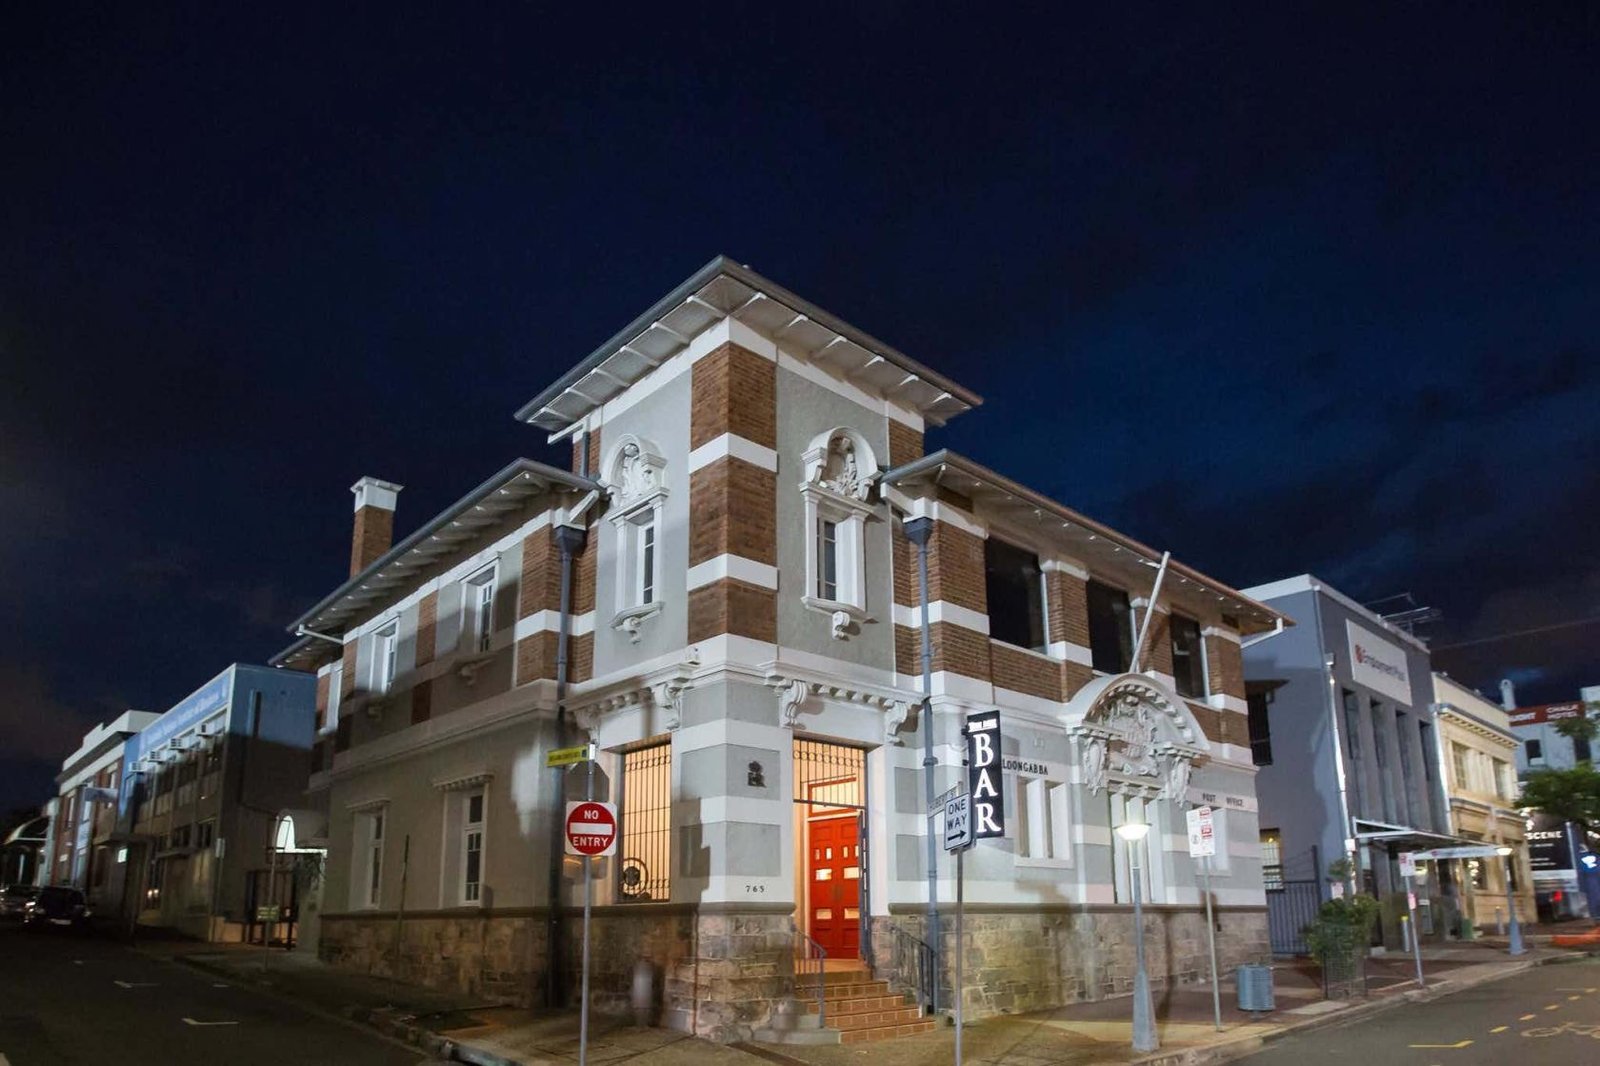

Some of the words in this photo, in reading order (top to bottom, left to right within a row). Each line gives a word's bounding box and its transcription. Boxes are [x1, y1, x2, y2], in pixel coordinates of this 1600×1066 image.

[1002, 759, 1048, 775] LOONGABBA
[973, 733, 1001, 833] BAR
[584, 810, 599, 819] NO
[948, 799, 966, 815] ONE
[947, 814, 967, 830] WAY
[573, 836, 609, 847] ENTRY
[745, 885, 764, 893] 765
